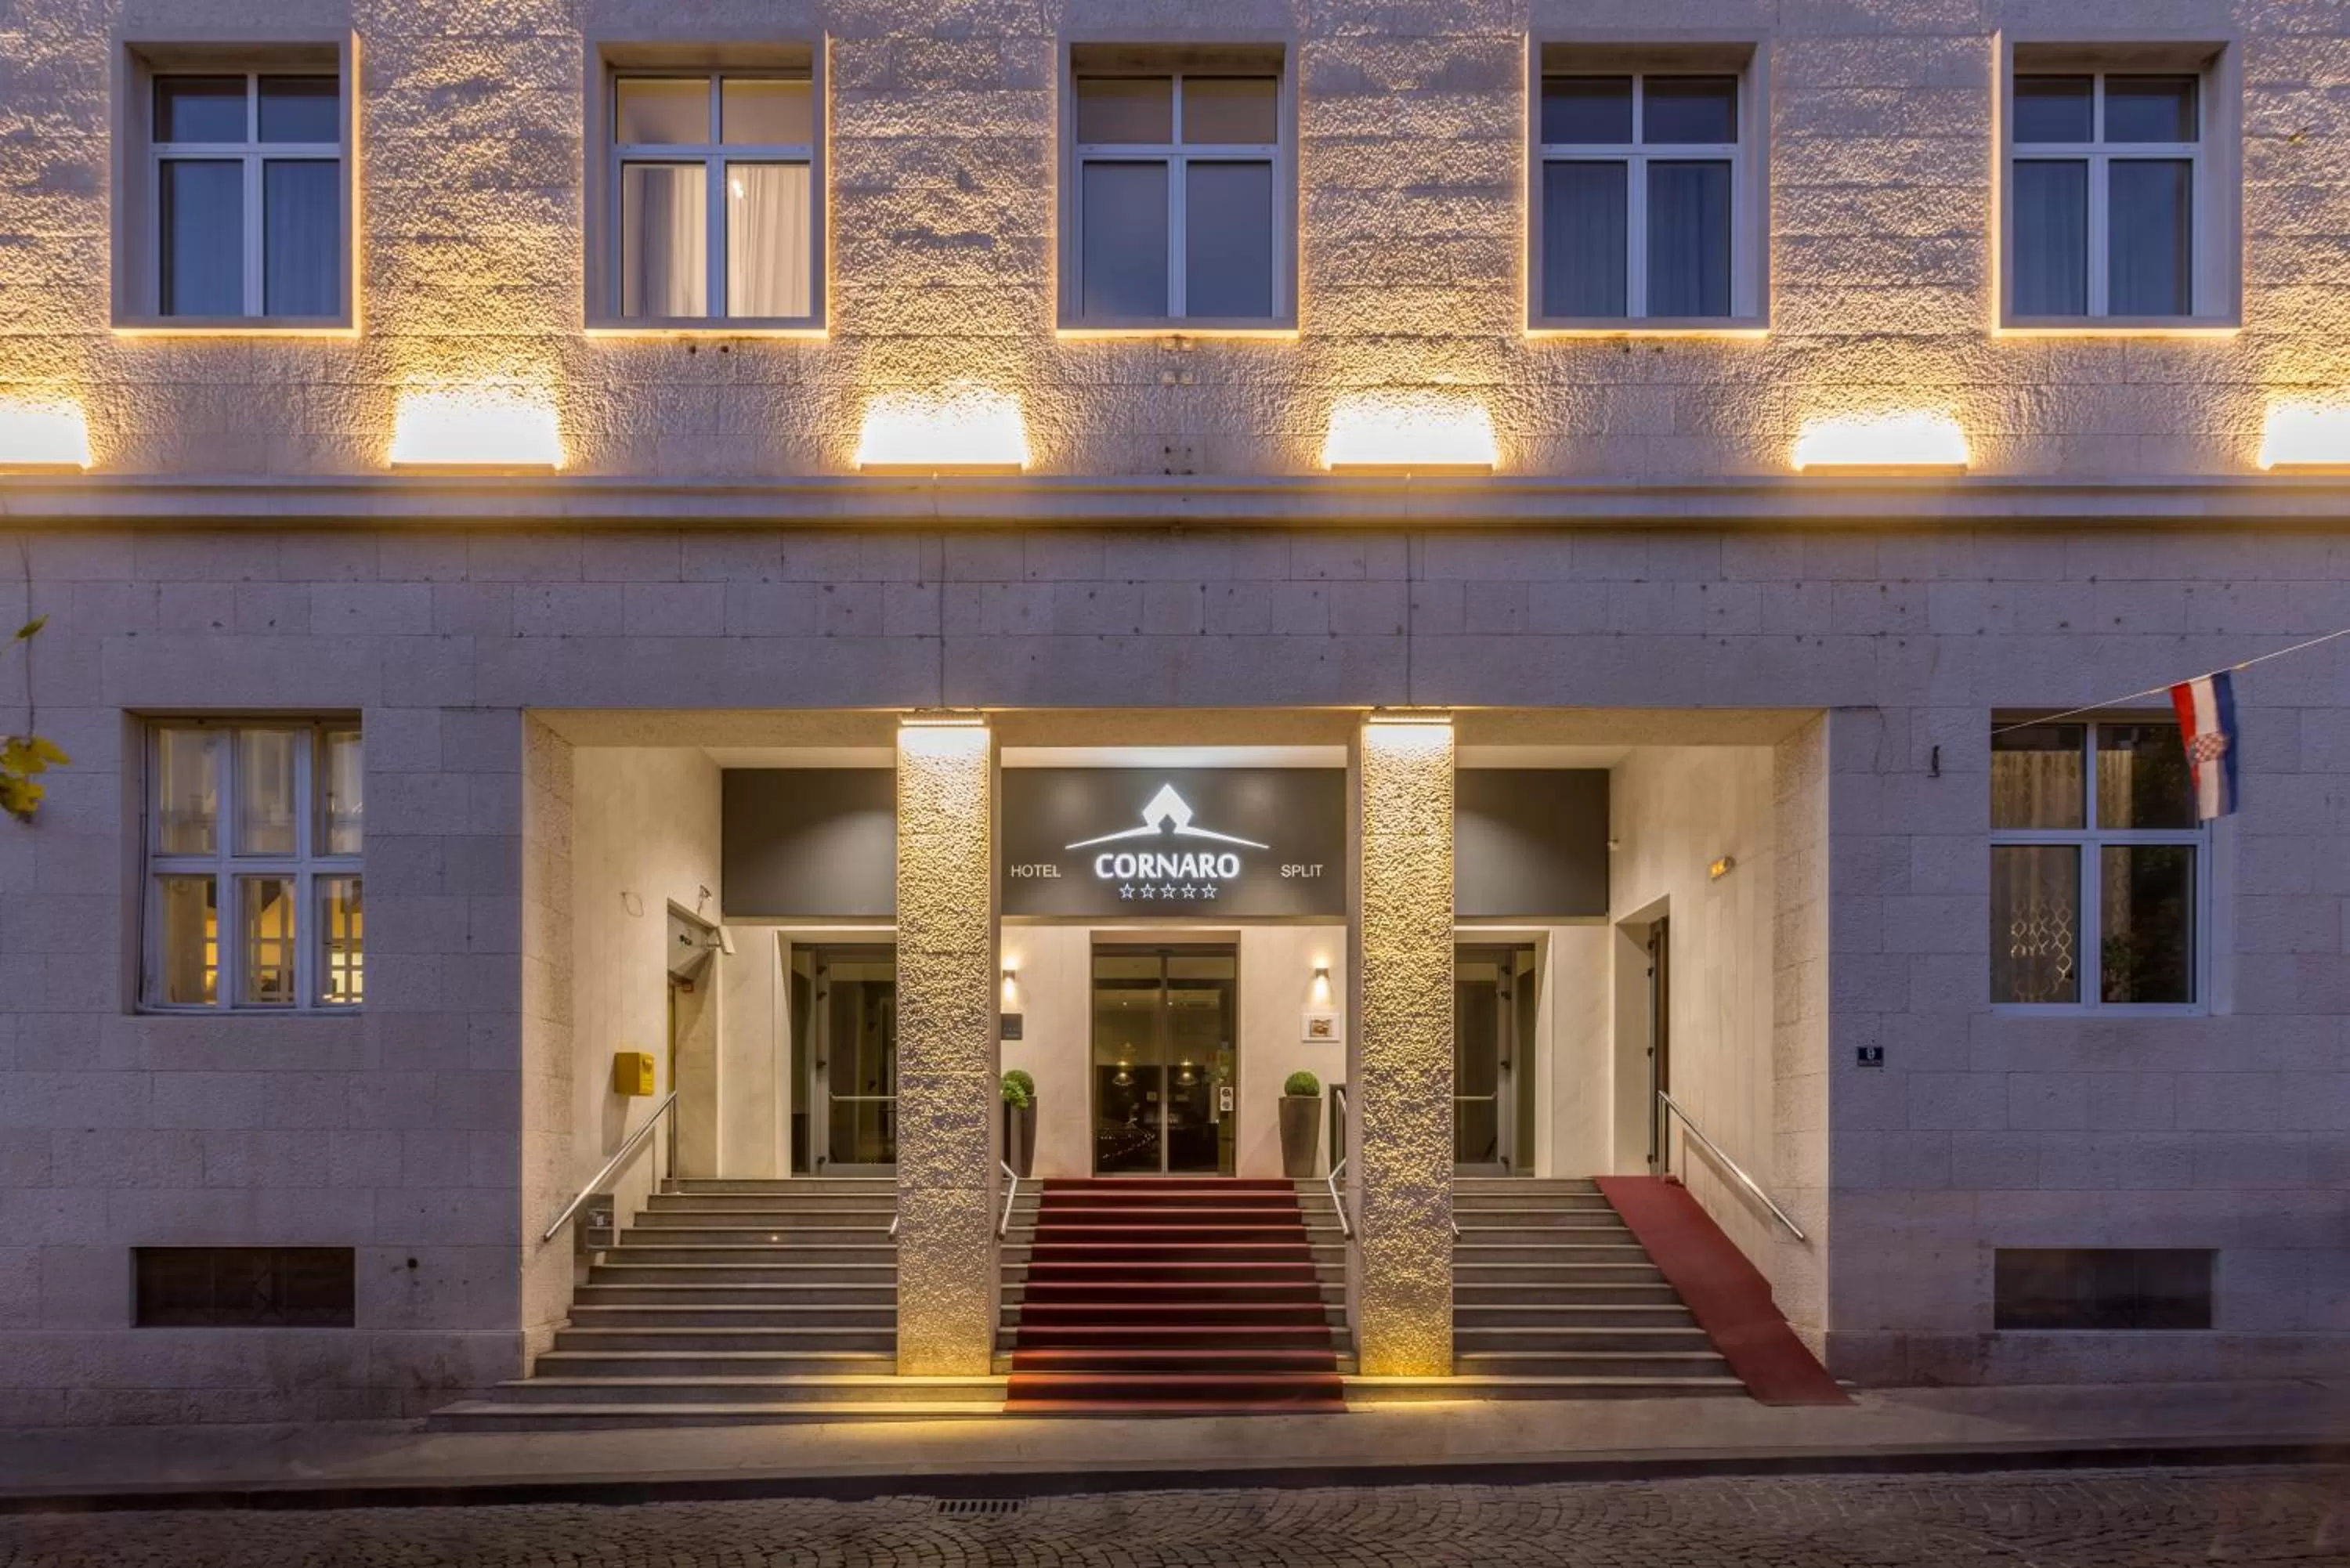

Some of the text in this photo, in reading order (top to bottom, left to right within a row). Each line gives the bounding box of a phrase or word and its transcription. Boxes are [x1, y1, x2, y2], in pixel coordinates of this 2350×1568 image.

[1010, 853, 1324, 879] HOTEL CORNARO SPLIT
